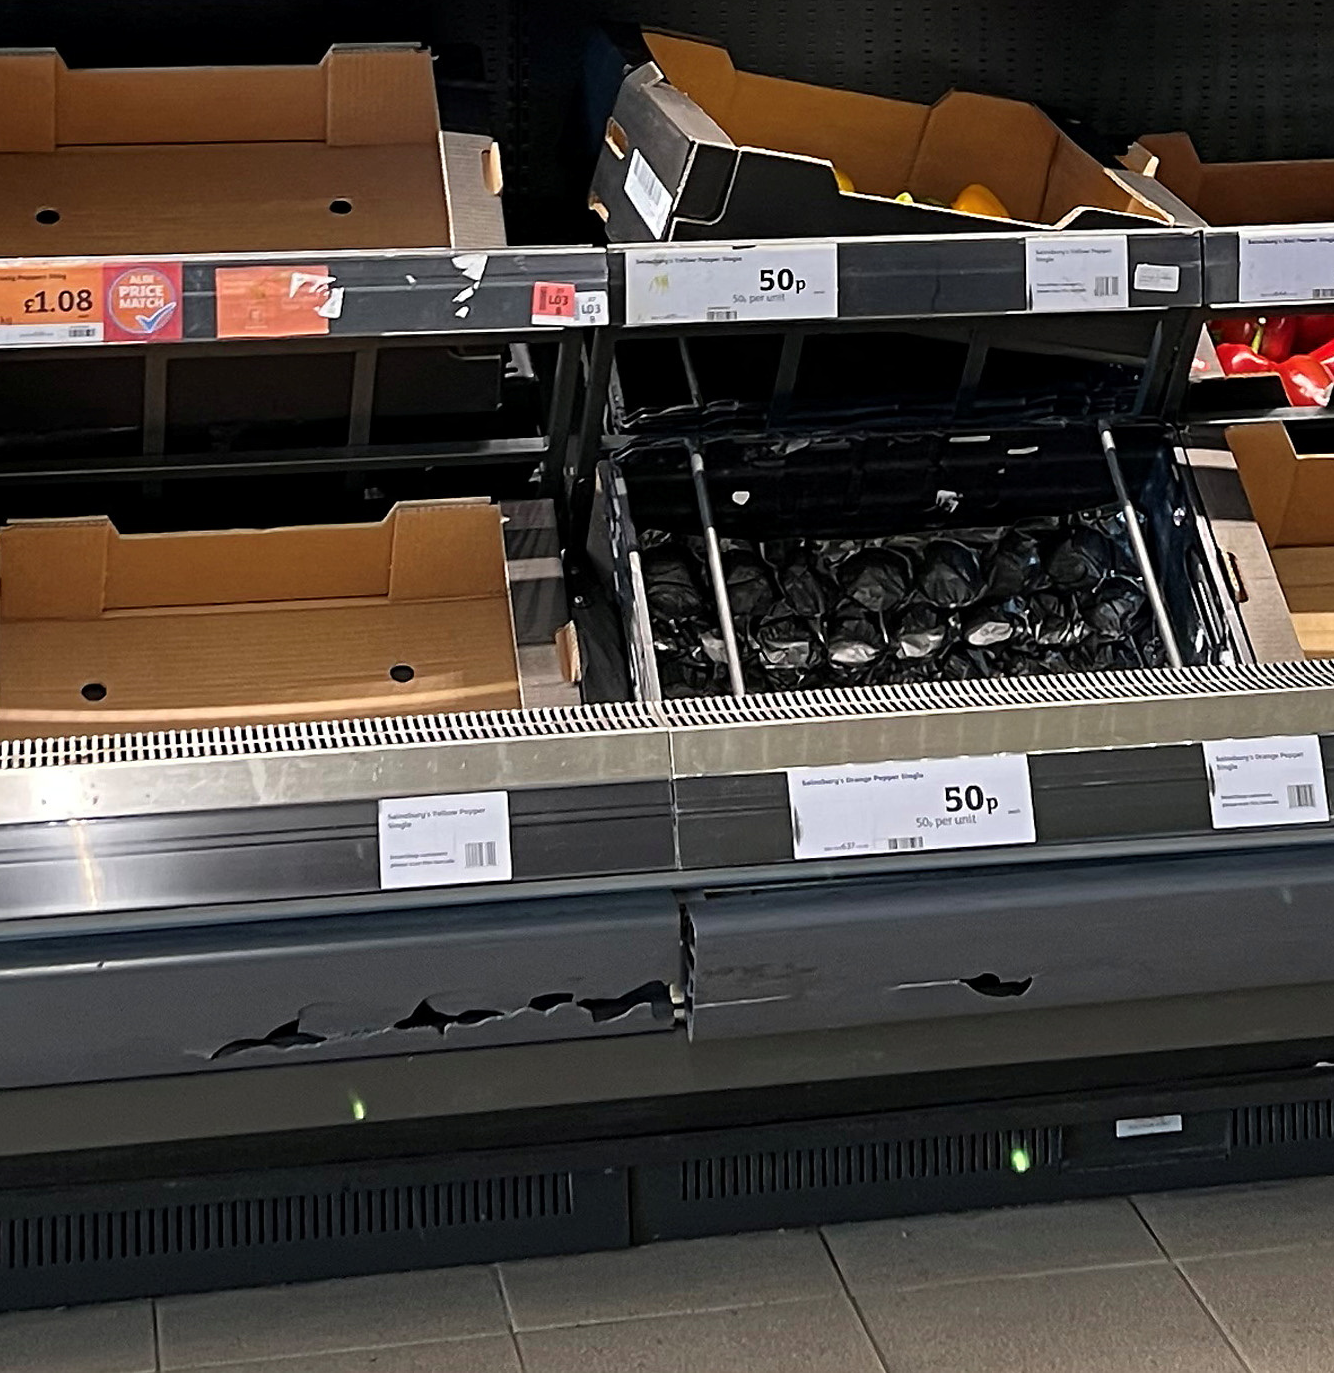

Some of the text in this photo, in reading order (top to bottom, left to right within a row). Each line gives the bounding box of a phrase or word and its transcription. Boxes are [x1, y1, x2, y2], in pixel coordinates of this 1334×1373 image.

[759, 268, 806, 294] 50p
[118, 284, 164, 298] PRICE
[24, 289, 93, 314] £1.08
[119, 298, 164, 309] MATCH
[548, 295, 569, 306] L03
[749, 295, 765, 304] per
[767, 293, 786, 303] unit
[581, 303, 602, 315] L03
[846, 775, 872, 784] Orange
[874, 774, 899, 782] Pepper
[901, 772, 924, 780] Single
[944, 784, 999, 815] 50p
[459, 807, 486, 815] Pepper
[935, 816, 953, 828] per
[955, 814, 977, 825] unit
